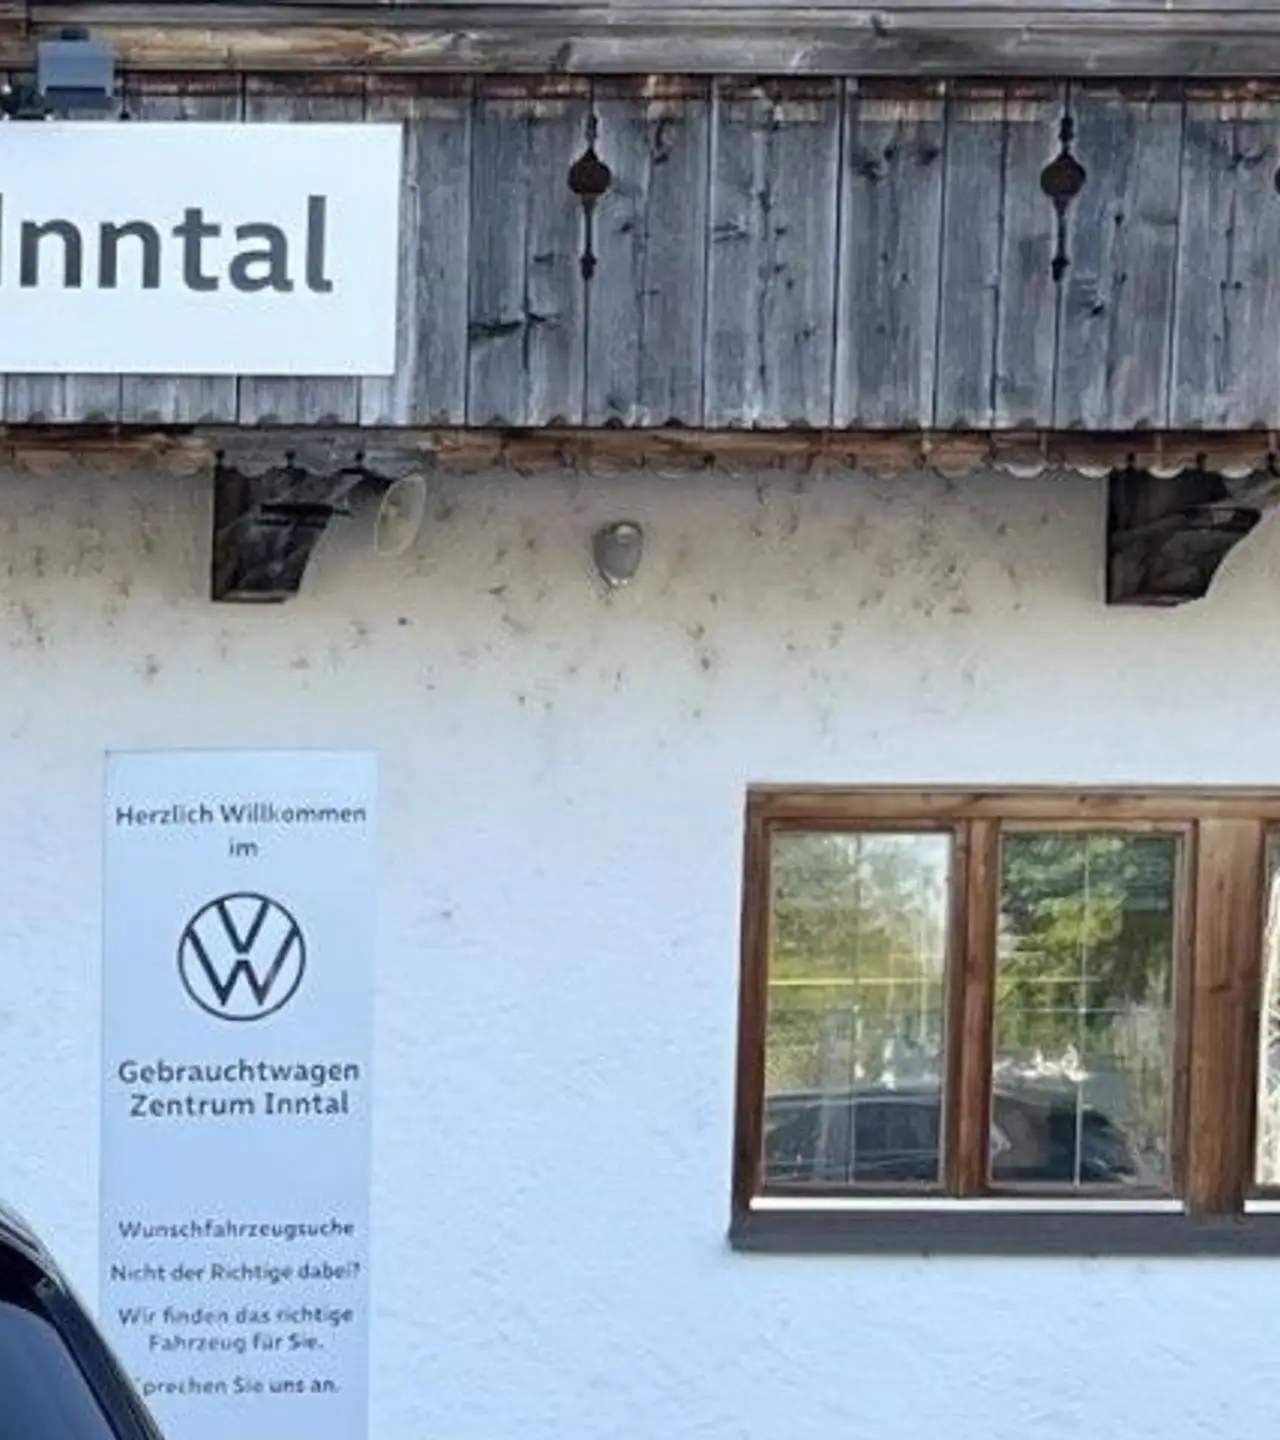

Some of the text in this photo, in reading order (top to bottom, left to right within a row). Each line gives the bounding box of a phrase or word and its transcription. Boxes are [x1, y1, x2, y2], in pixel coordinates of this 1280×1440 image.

[116, 803, 367, 826] Herzlich Willkommen
[229, 838, 258, 858] im
[178, 891, 306, 1022] VW
[118, 1059, 360, 1087] Gebrauchtwagen
[130, 1091, 350, 1117] Zentrum Inntal
[119, 1218, 354, 1240] Wunschfahrzeugsuche
[110, 1261, 361, 1284] Nicht der Richtige dabei?
[118, 1305, 354, 1327] Wir finden das richtige
[148, 1332, 324, 1353] Fahrzeug für Sie.
[136, 1375, 341, 1397] prechen Sie uns an.
